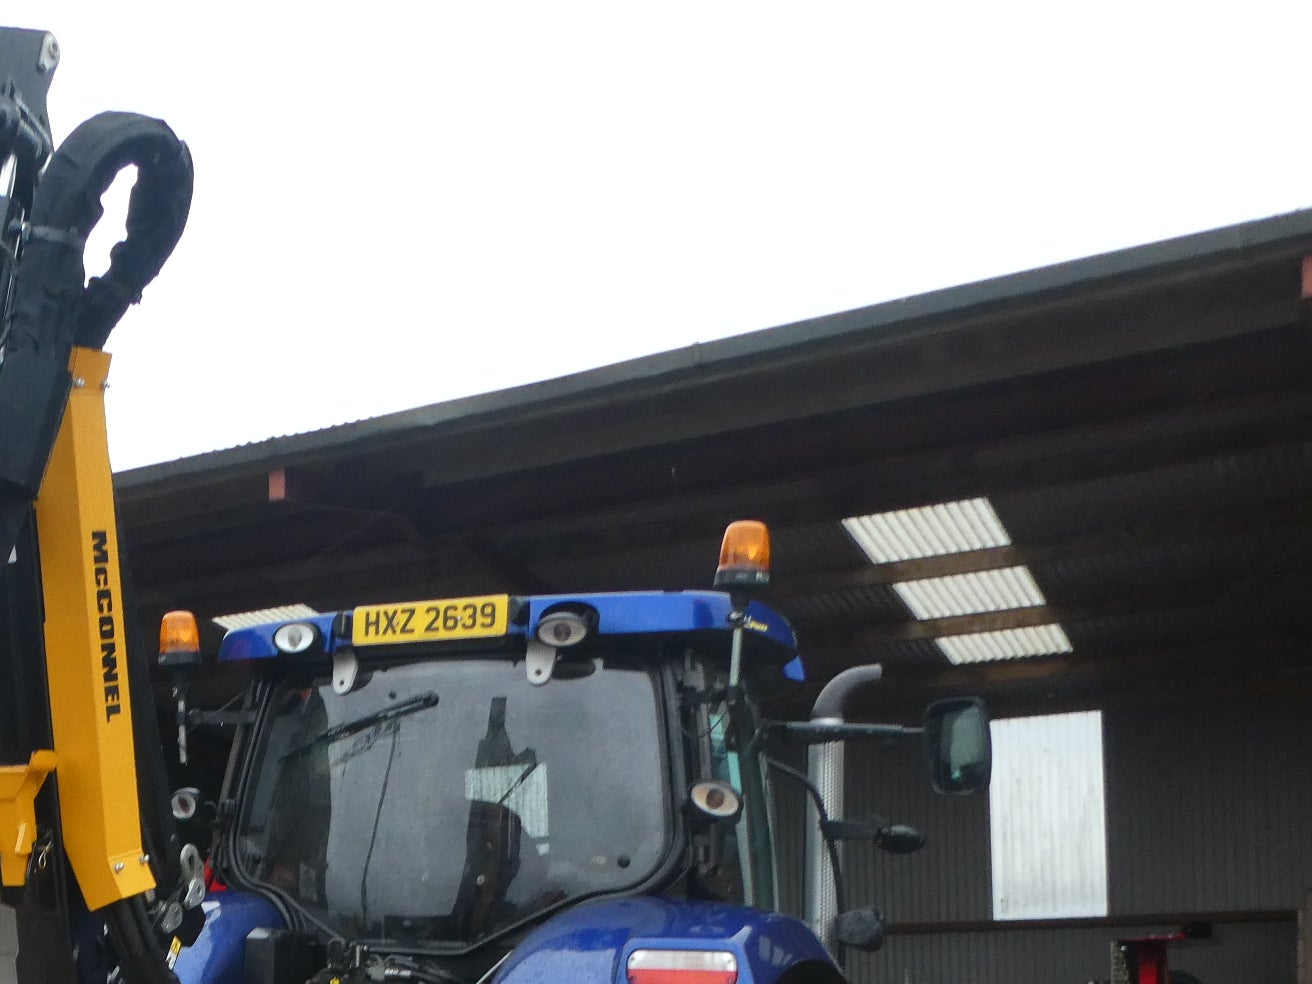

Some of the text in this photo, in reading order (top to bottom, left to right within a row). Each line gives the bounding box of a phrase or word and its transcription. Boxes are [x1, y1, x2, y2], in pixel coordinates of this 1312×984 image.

[92, 528, 122, 724] McCONNEL
[364, 602, 497, 637] HXZ 2639
